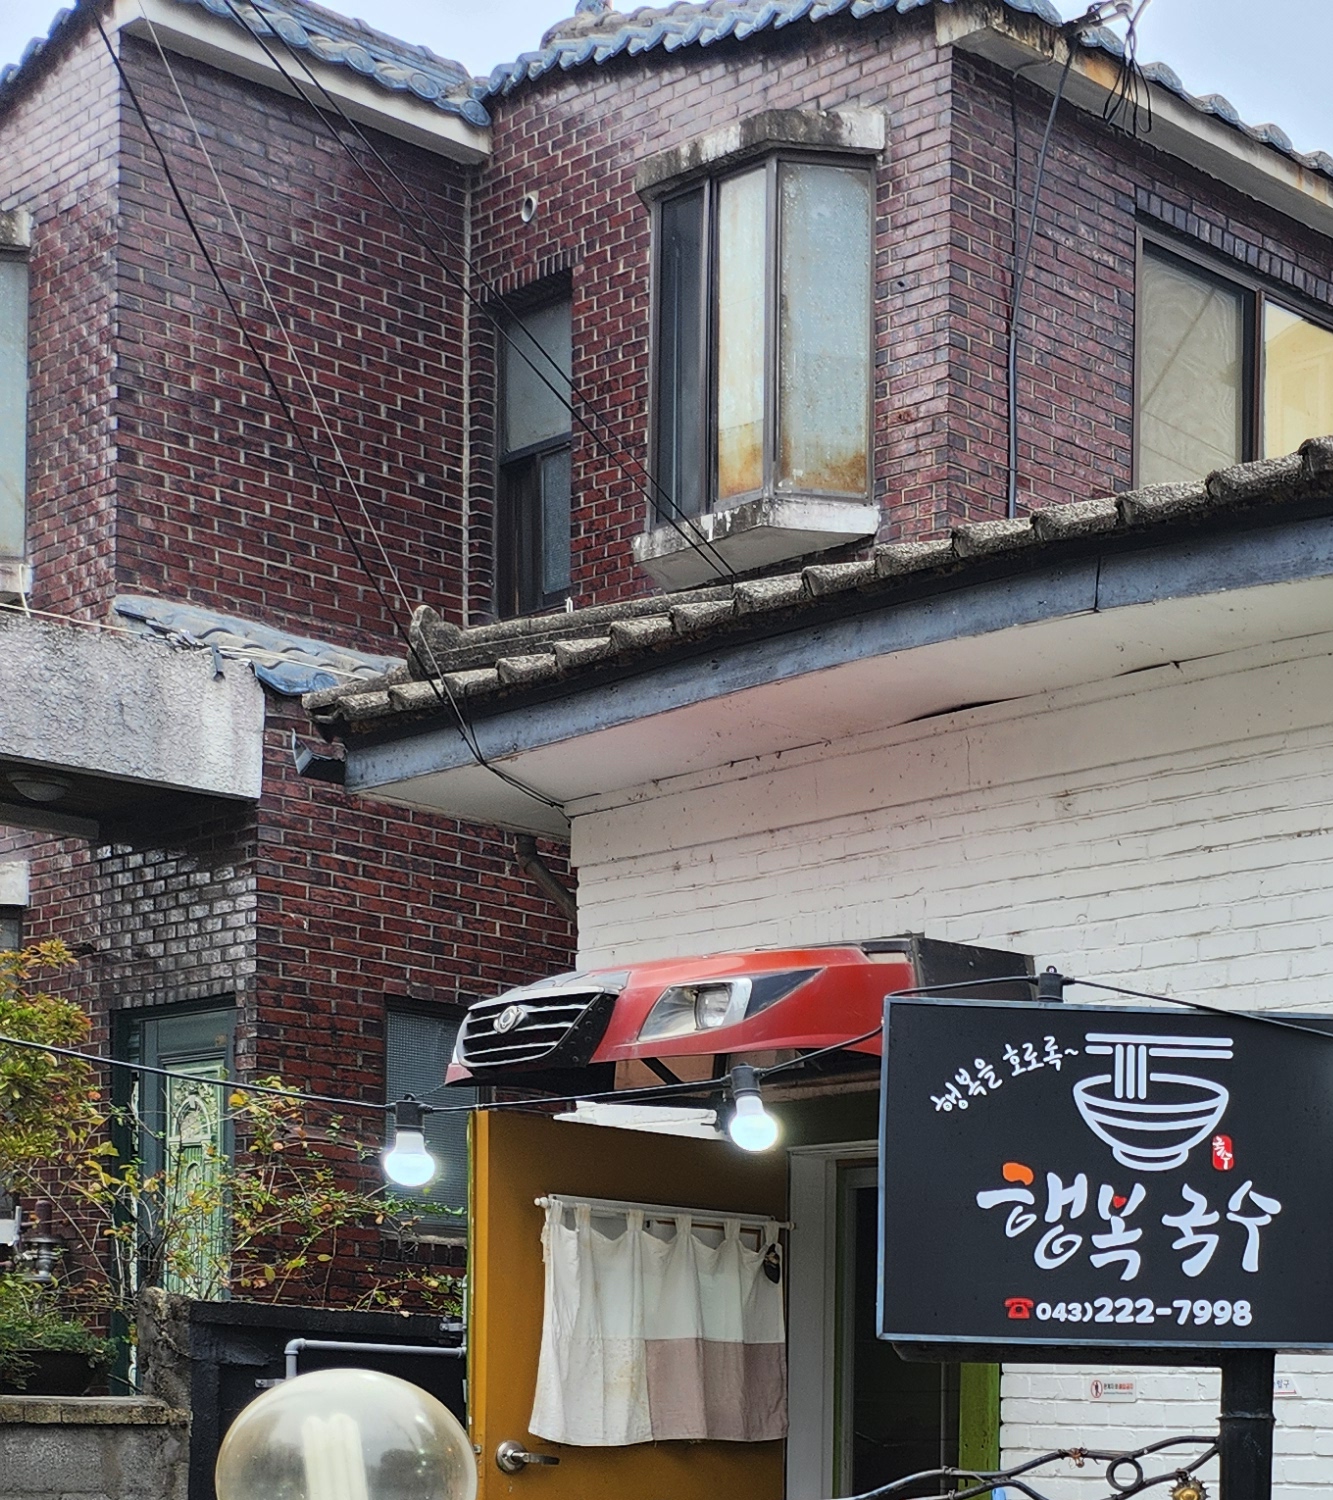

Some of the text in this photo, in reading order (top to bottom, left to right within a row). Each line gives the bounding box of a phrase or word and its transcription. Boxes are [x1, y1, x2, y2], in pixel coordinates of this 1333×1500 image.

[930, 1035, 1079, 1112] 행복을 호로록~
[1035, 1296, 1253, 1327] 043)222-7998
